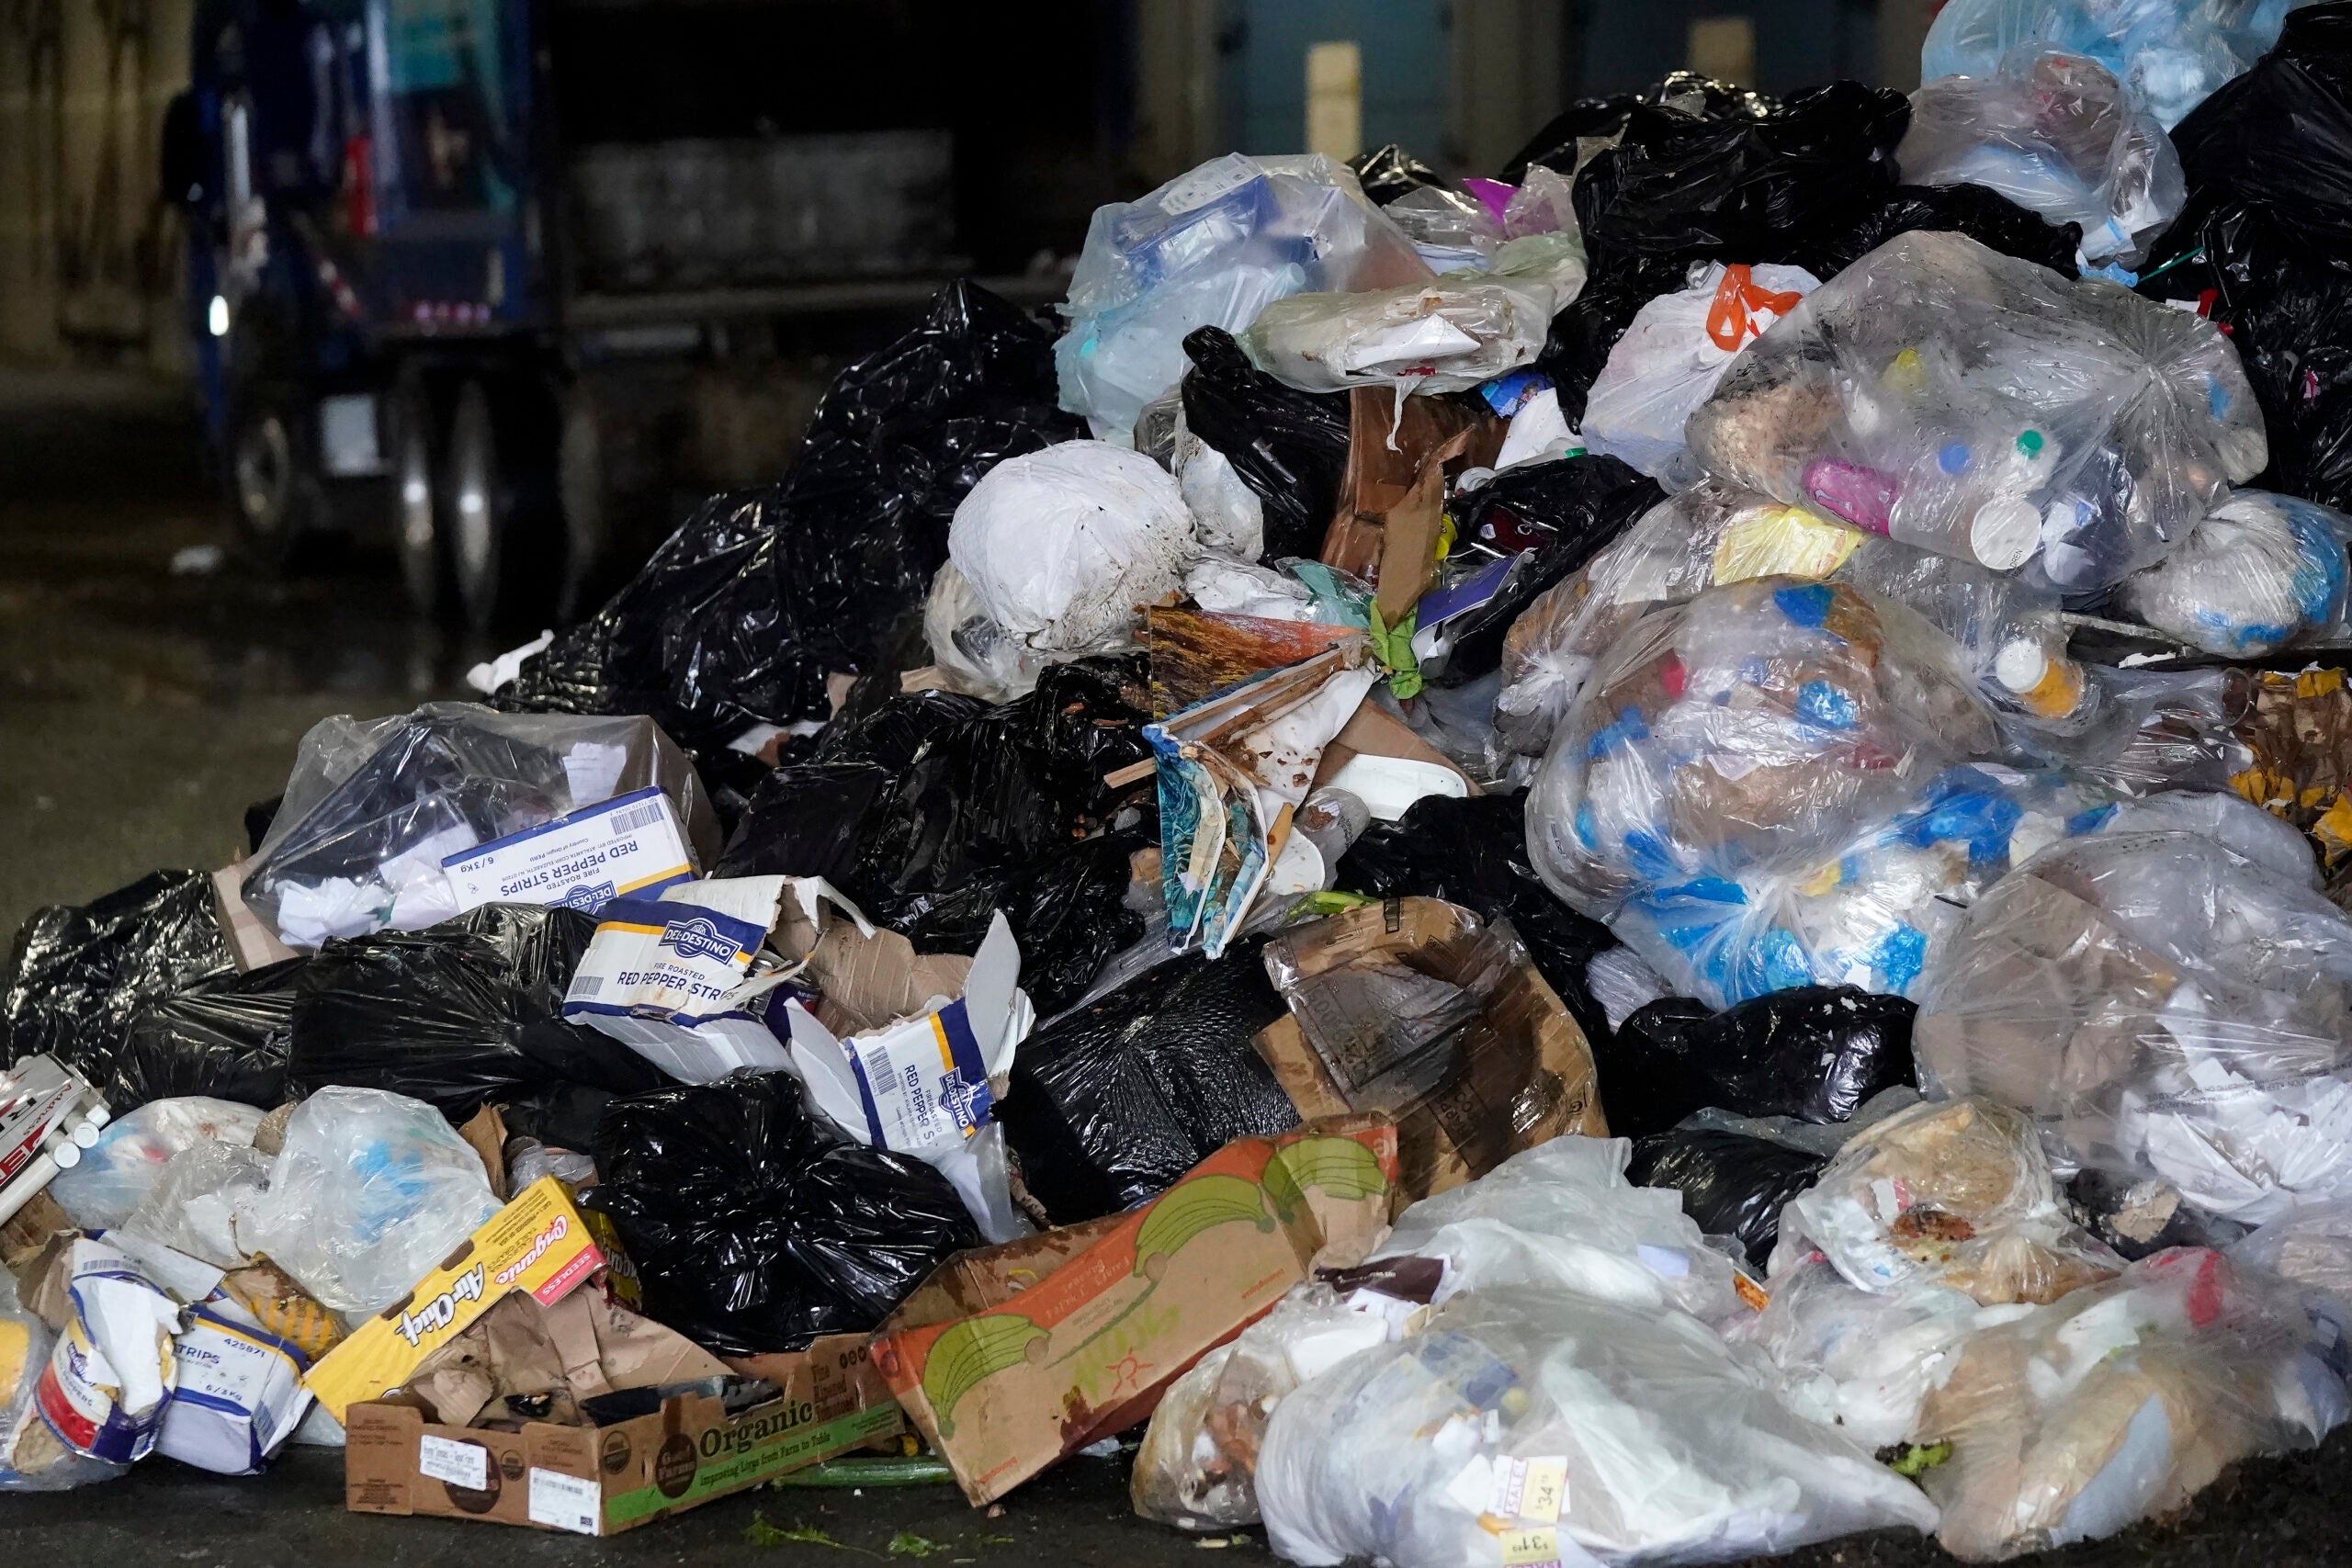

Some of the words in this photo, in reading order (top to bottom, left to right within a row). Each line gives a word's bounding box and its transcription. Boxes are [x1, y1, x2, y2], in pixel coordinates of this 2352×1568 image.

[569, 838, 589, 848] Country
[609, 840, 639, 859] RED
[529, 852, 546, 863] PERU
[552, 852, 606, 878] PEPPER
[546, 874, 582, 890] ROASTED
[583, 867, 601, 878] FIRE
[500, 872, 549, 897] STRIPS
[617, 971, 639, 986] RED
[640, 972, 687, 989] PEPPER
[653, 962, 666, 970] FIRE
[667, 964, 706, 981] ROASTED
[904, 1064, 919, 1088] RED
[910, 1088, 931, 1128] PEPPER
[494, 1214, 569, 1285] Organic
[542, 1252, 592, 1296] SEEDLESS
[177, 1344, 221, 1365] TRIPS
[699, 1401, 813, 1459] Organic
[780, 1442, 800, 1459] Farm
[801, 1440, 809, 1450] to
